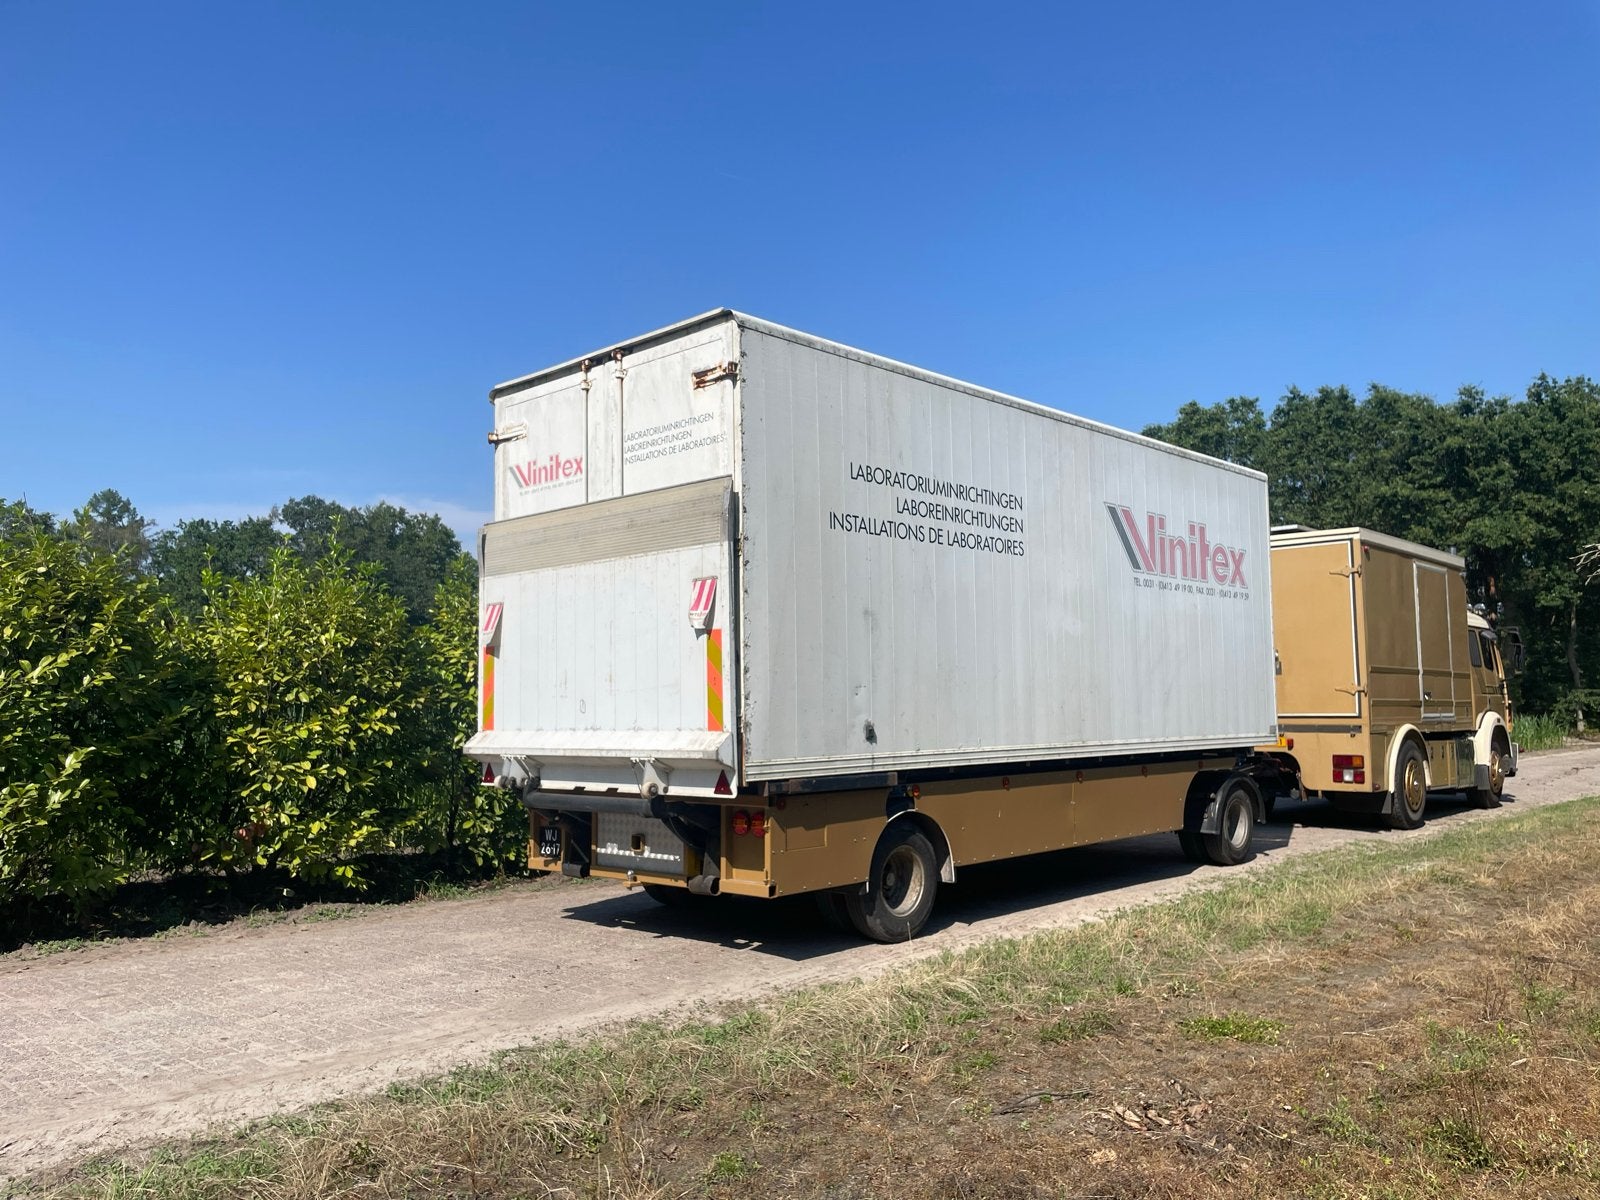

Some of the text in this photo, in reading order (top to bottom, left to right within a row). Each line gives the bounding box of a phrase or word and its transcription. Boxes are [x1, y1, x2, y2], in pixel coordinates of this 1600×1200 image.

[624, 412, 714, 443] LABORATORIUMINRICHTINGEN
[624, 430, 692, 454] LABOREINRICHTUNGEN
[624, 433, 724, 465] INSTALLATIONS DE LABORATOIRES
[509, 453, 583, 488] Vinitex
[850, 462, 1022, 511] LABORATORIUMINRICHTINGEN
[896, 496, 1023, 534] LABOREINRICHTUNGEN
[829, 511, 1025, 557] INSTALLATIONS DE LABORATOIRES
[1104, 501, 1248, 589] Vinitex
[1142, 578, 1155, 588] 0031
[1174, 583, 1180, 591] 49
[545, 829, 558, 842] WJ
